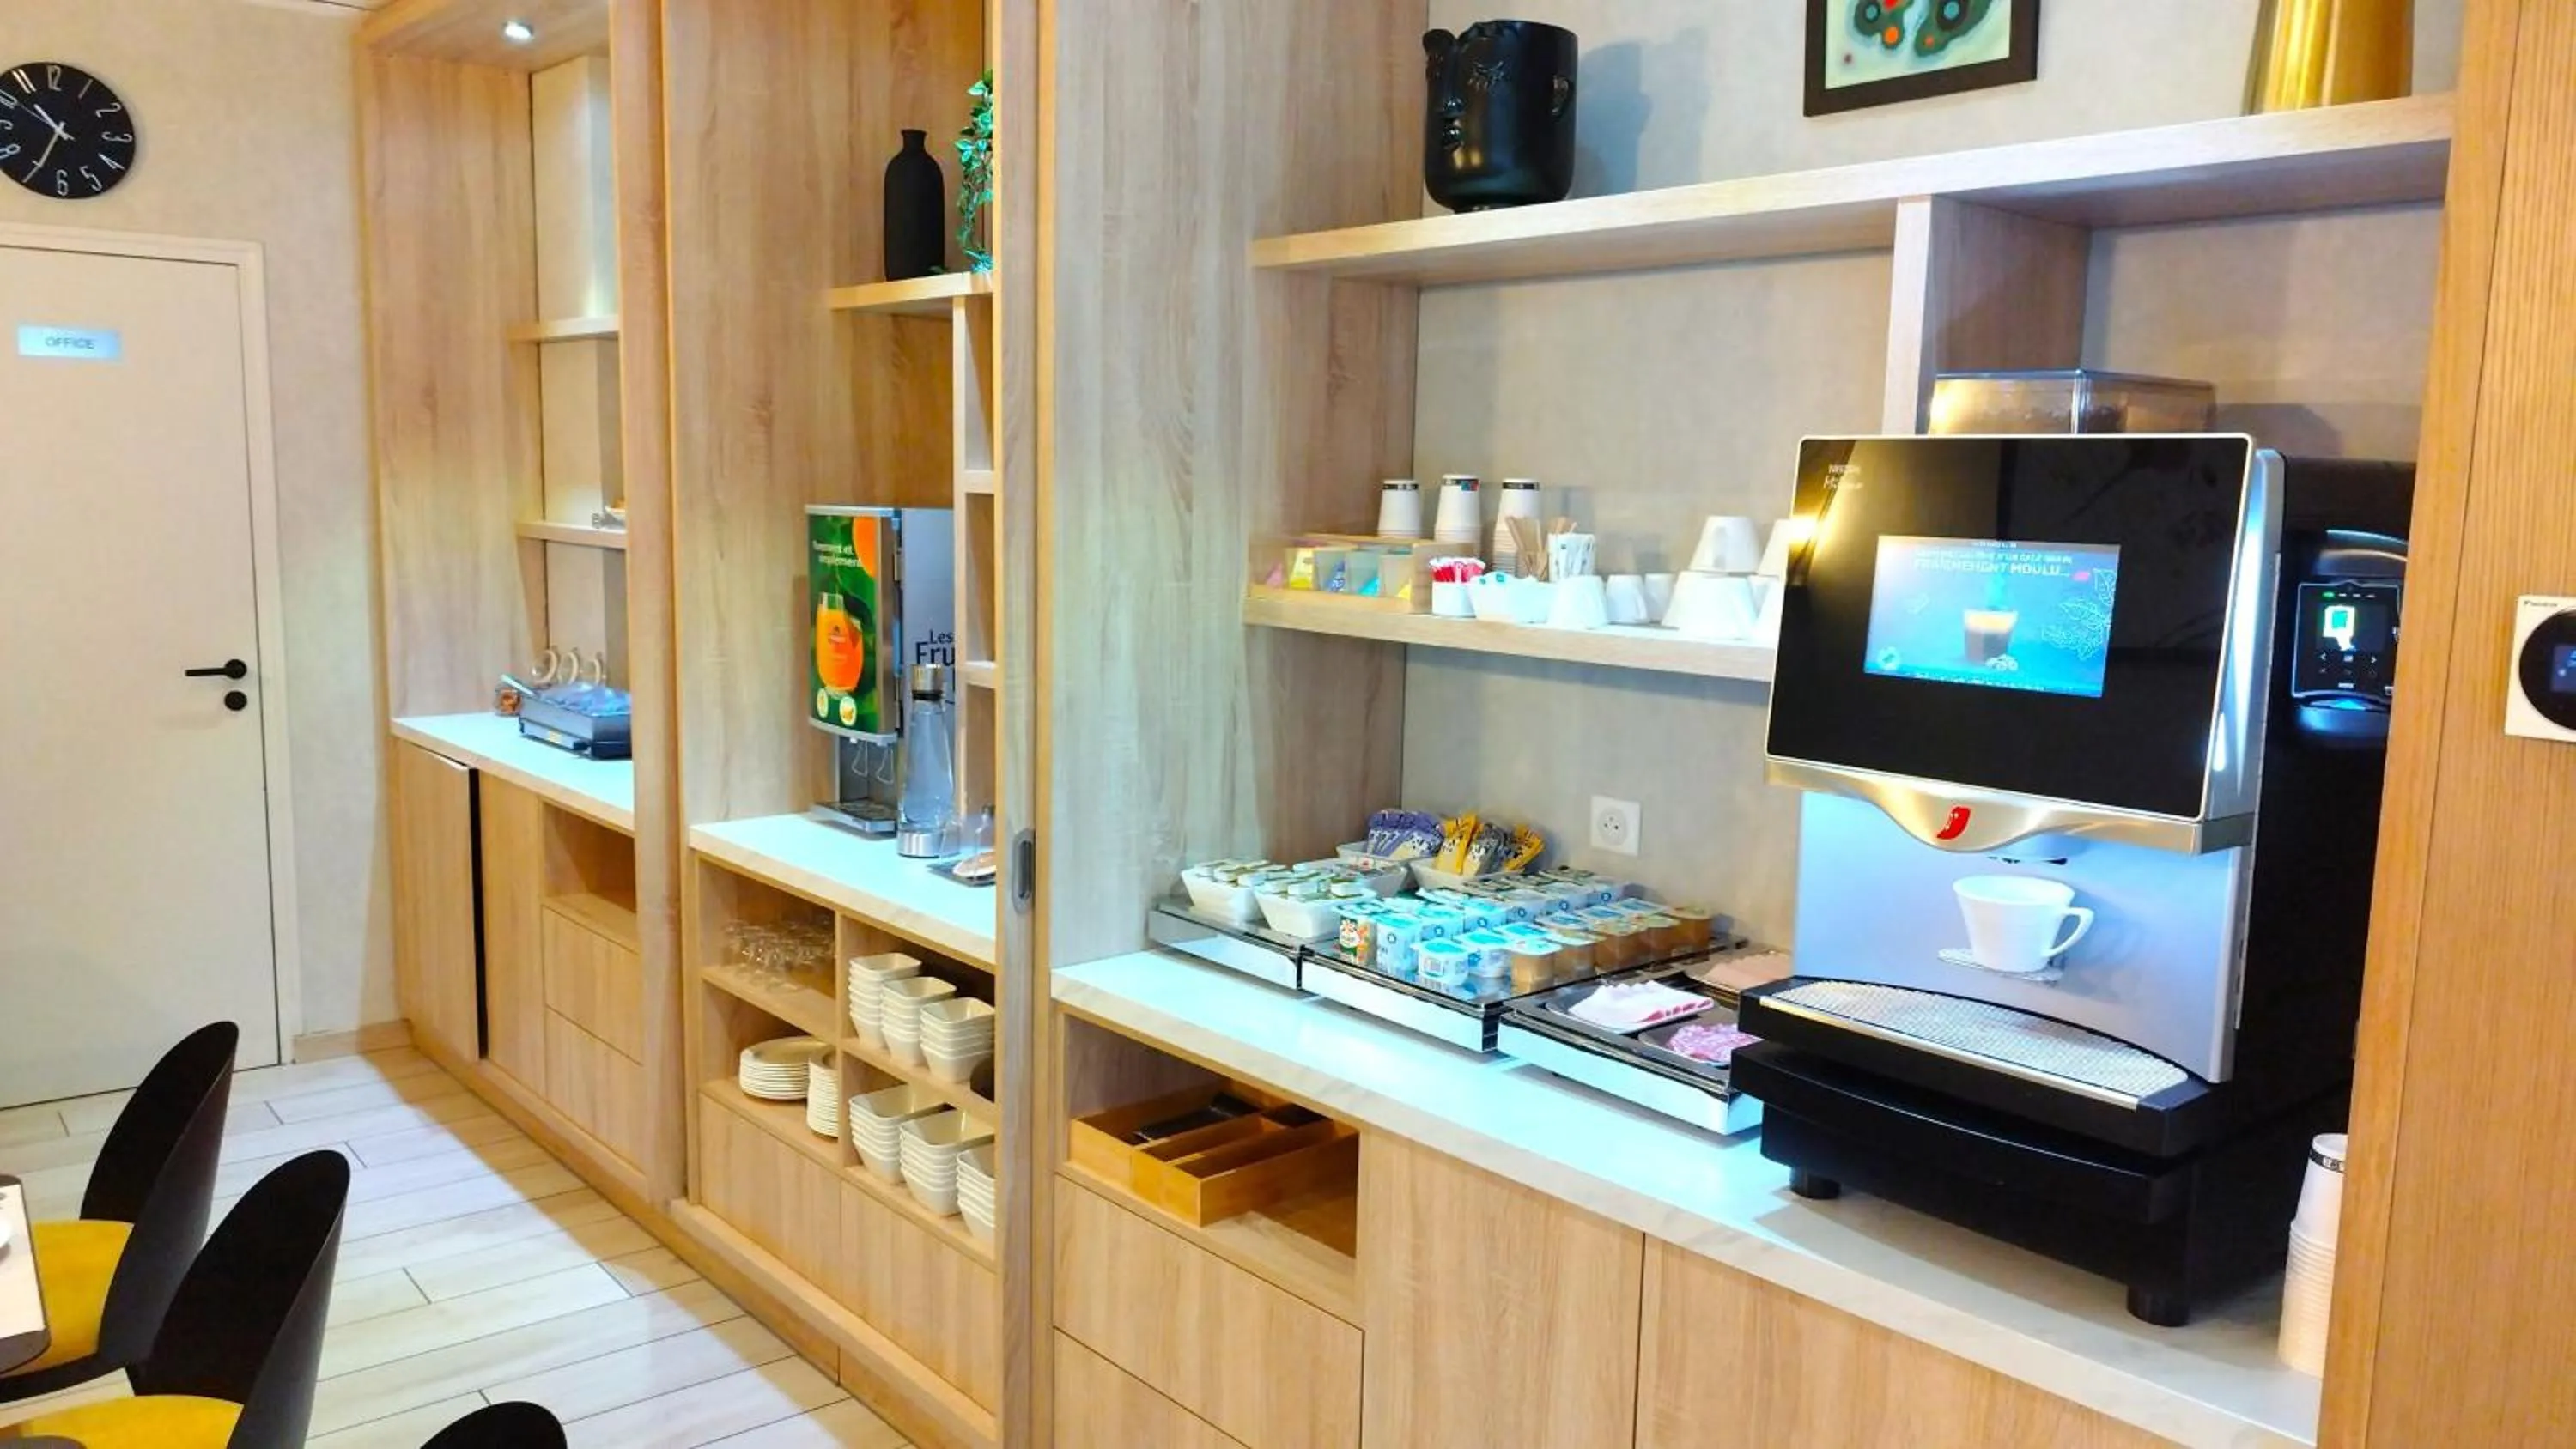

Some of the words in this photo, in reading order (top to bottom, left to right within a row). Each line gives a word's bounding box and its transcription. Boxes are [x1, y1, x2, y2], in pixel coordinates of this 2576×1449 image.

[46, 64, 63, 92] 12
[94, 101, 122, 118] 2
[100, 130, 133, 144] 3
[56, 168, 70, 197] 6
[79, 165, 103, 192] 5
[44, 336, 95, 350] OFFICE
[929, 629, 954, 645] Les
